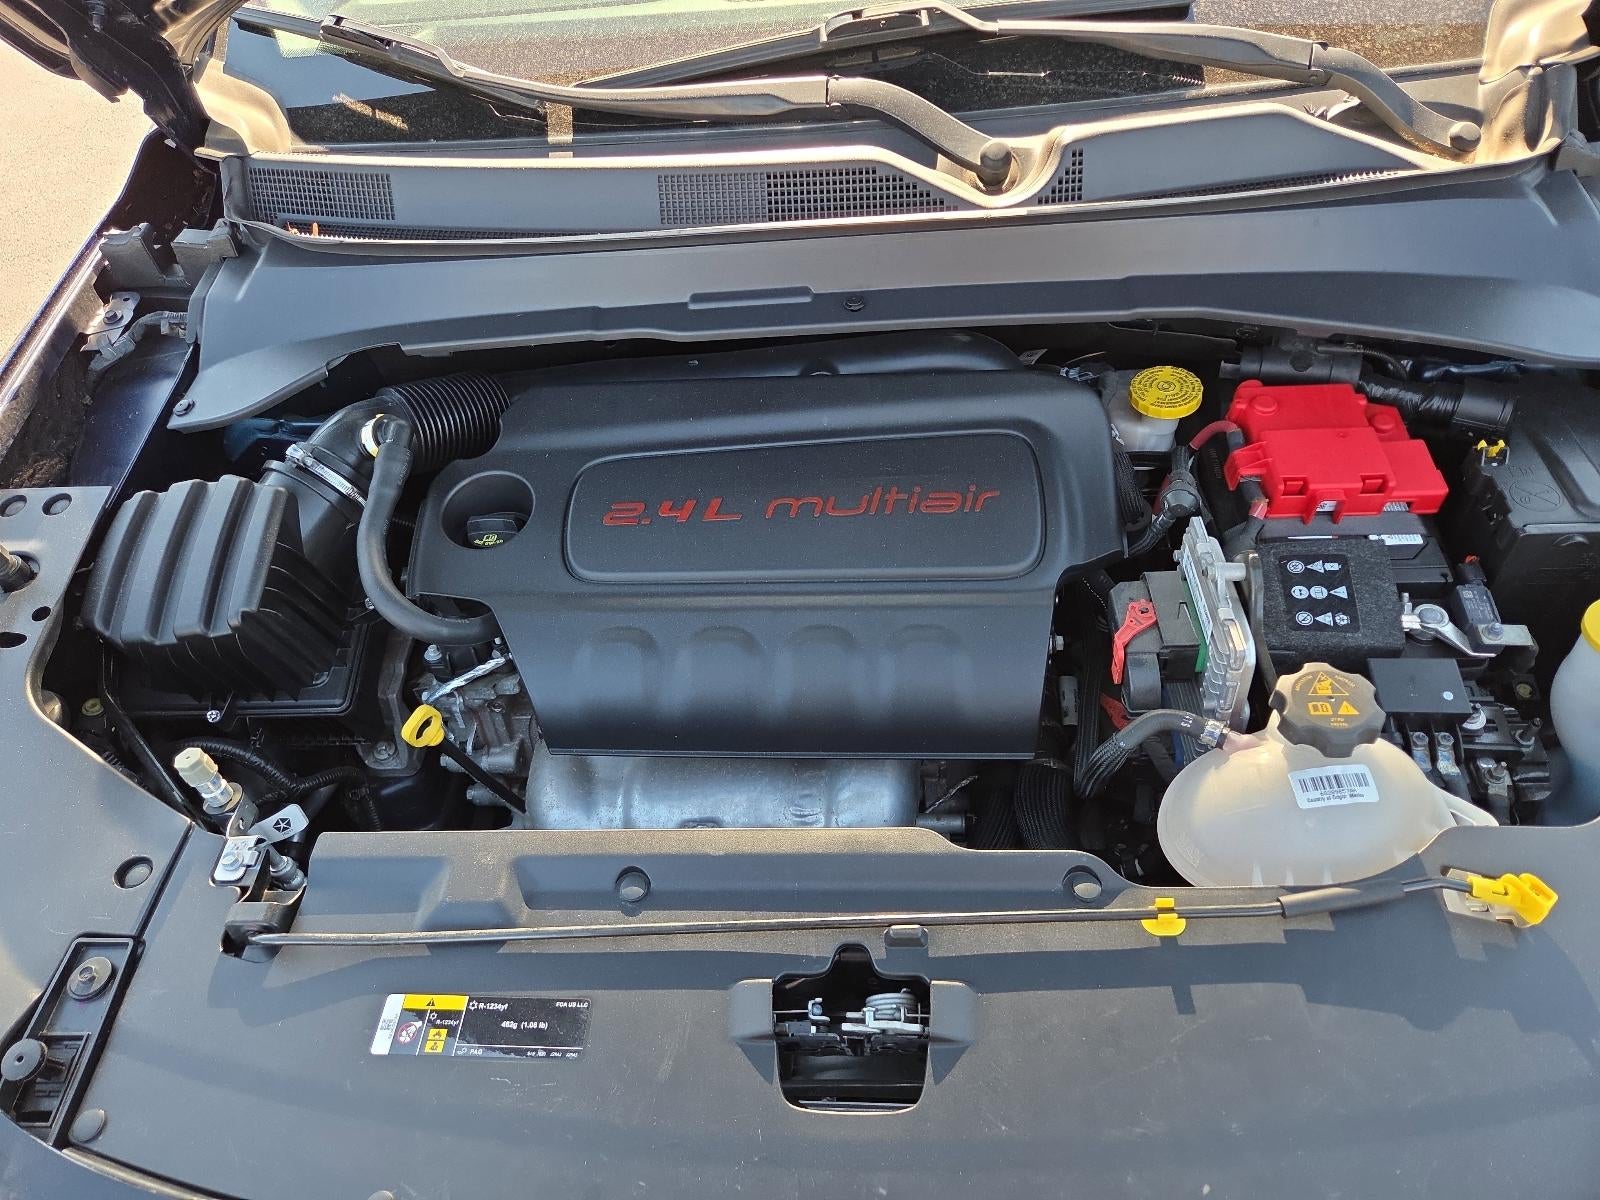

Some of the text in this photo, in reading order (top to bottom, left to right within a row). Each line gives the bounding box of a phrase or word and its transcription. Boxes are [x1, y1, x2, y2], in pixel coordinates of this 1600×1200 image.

[765, 483, 1000, 520] multiair
[478, 1002, 508, 1012] R-1234yf
[538, 1021, 549, 1030] lb)
